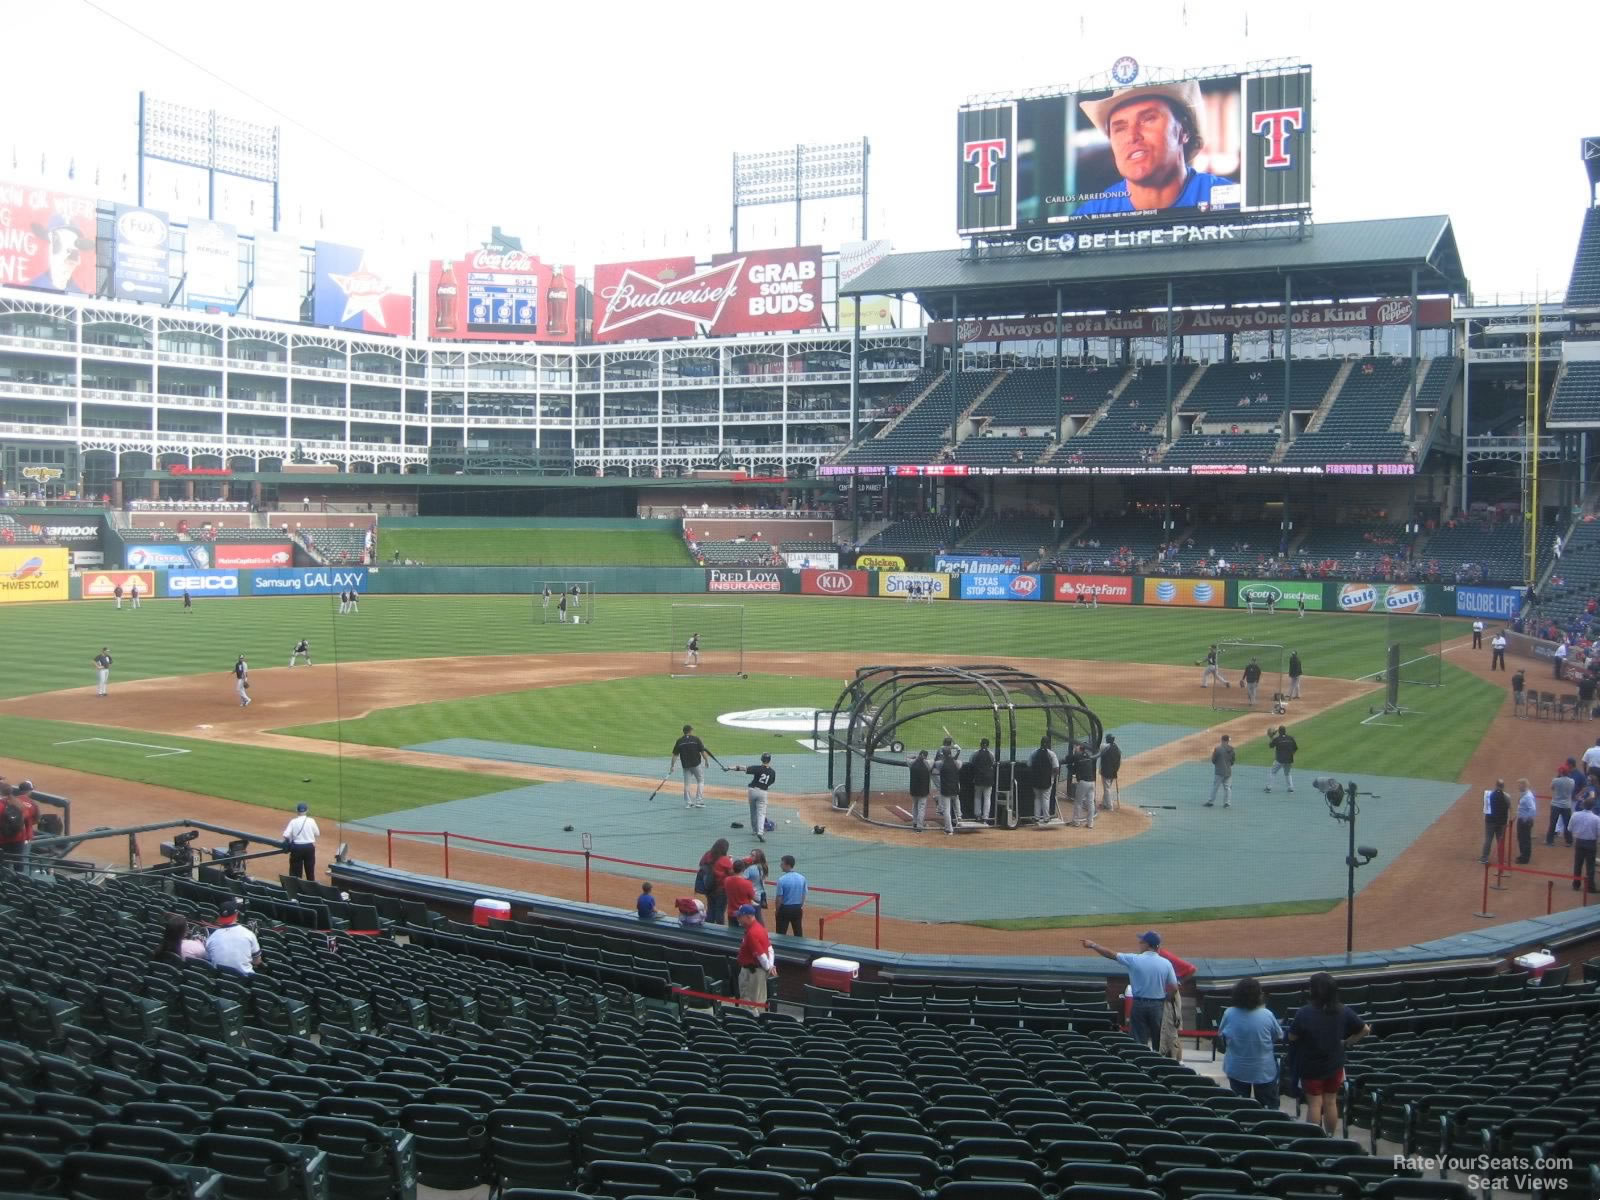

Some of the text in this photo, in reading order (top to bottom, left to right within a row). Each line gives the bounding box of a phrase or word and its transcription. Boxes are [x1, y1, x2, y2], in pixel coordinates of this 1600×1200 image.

[1252, 107, 1304, 168] T
[964, 138, 1007, 194] T
[1045, 191, 1131, 204] CARLOS ARREDONDO
[1114, 229, 1164, 246] LIFE
[1172, 223, 1235, 243] PARK
[473, 250, 534, 271] Coca-Cola
[748, 261, 815, 284] GRAB
[601, 281, 737, 313] Budweiser
[759, 281, 803, 297] SOME
[748, 293, 815, 316] BUDS
[1389, 301, 1403, 312] Dr
[1192, 308, 1251, 328] Always
[1254, 309, 1288, 324] One
[1290, 307, 1311, 322] of
[1311, 310, 1320, 322] a
[1324, 306, 1367, 322] Kind
[1381, 306, 1412, 323] Pepper
[987, 320, 1041, 338] Always
[1076, 319, 1092, 332] of
[1104, 316, 1143, 331] Kind
[1259, 465, 1272, 473] the
[1326, 464, 1373, 475] FIREWORKS
[1377, 464, 1415, 475] FRIDAYS
[863, 557, 897, 567] Chicken
[169, 575, 238, 590] GEICO
[255, 573, 363, 590] Samsung GALAXY
[711, 569, 779, 582] FRED LOYA
[822, 576, 847, 588] KIA
[974, 577, 998, 585] TEXAS
[710, 582, 779, 590] INSURANCE
[967, 586, 1005, 595] STOP SIGN
[1014, 580, 1033, 590] DQ
[1101, 585, 1127, 595] Farm
[1341, 590, 1374, 606] Gulf
[1386, 591, 1420, 608] Gulf
[1466, 593, 1498, 611] GLOBE
[759, 773, 769, 785] 21
